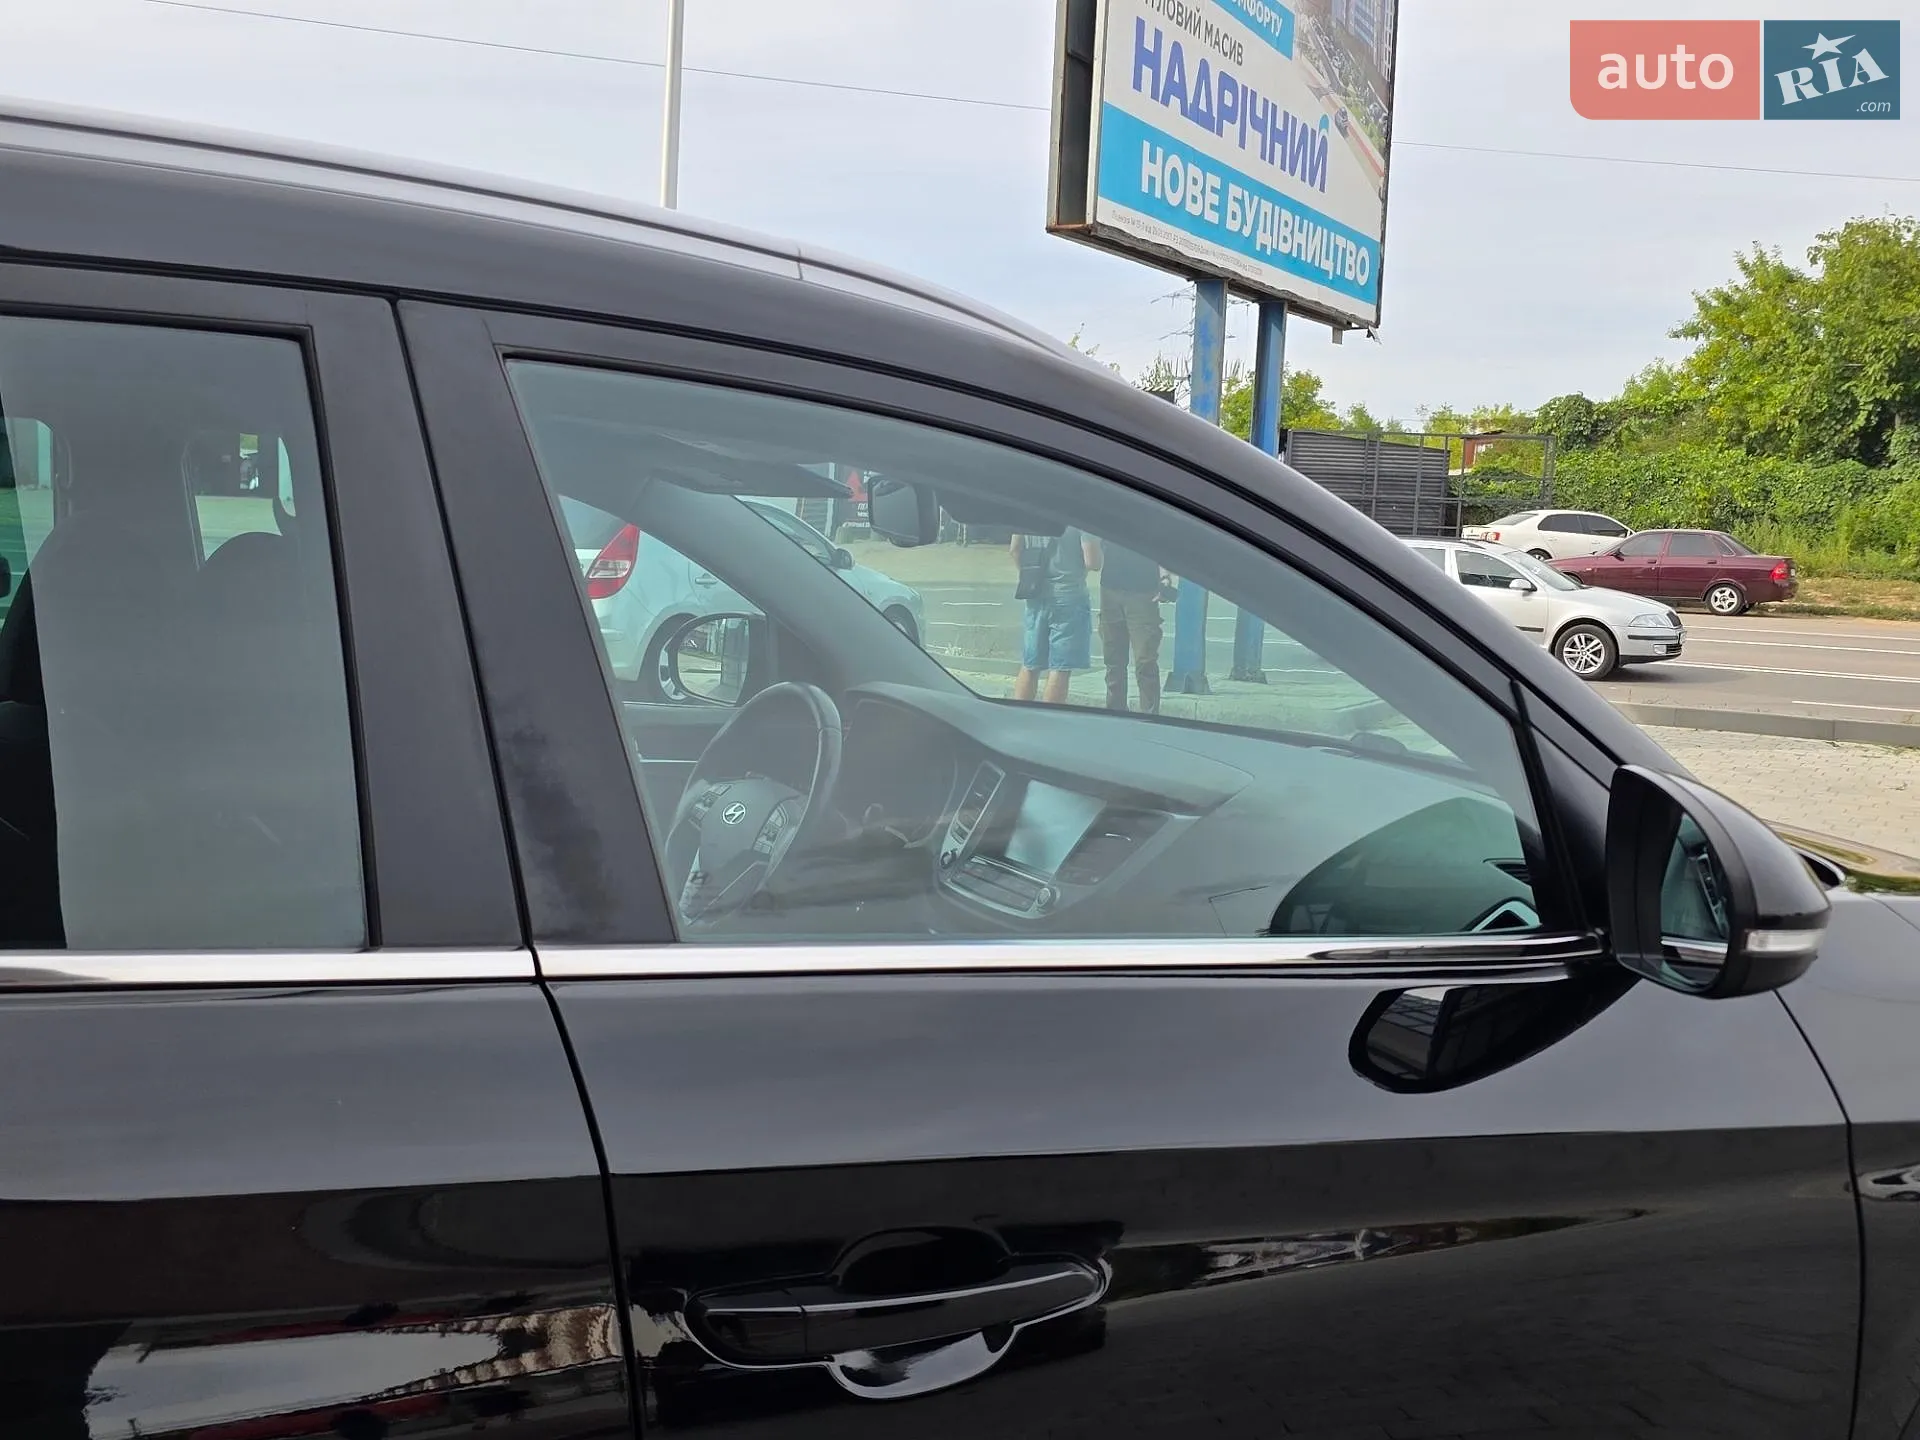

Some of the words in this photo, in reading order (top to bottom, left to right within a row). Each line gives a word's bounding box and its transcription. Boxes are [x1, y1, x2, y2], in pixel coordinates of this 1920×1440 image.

[1145, 0, 1202, 39] ЛОВИЙ
[1204, 20, 1243, 66] МАСИВ
[1232, 0, 1283, 37] ФОРТУ
[1133, 17, 1329, 193] НАДРІЧНИЙ
[1142, 141, 1221, 224] НОВЕ
[1226, 183, 1370, 286] БУДІВНИЦТВО
